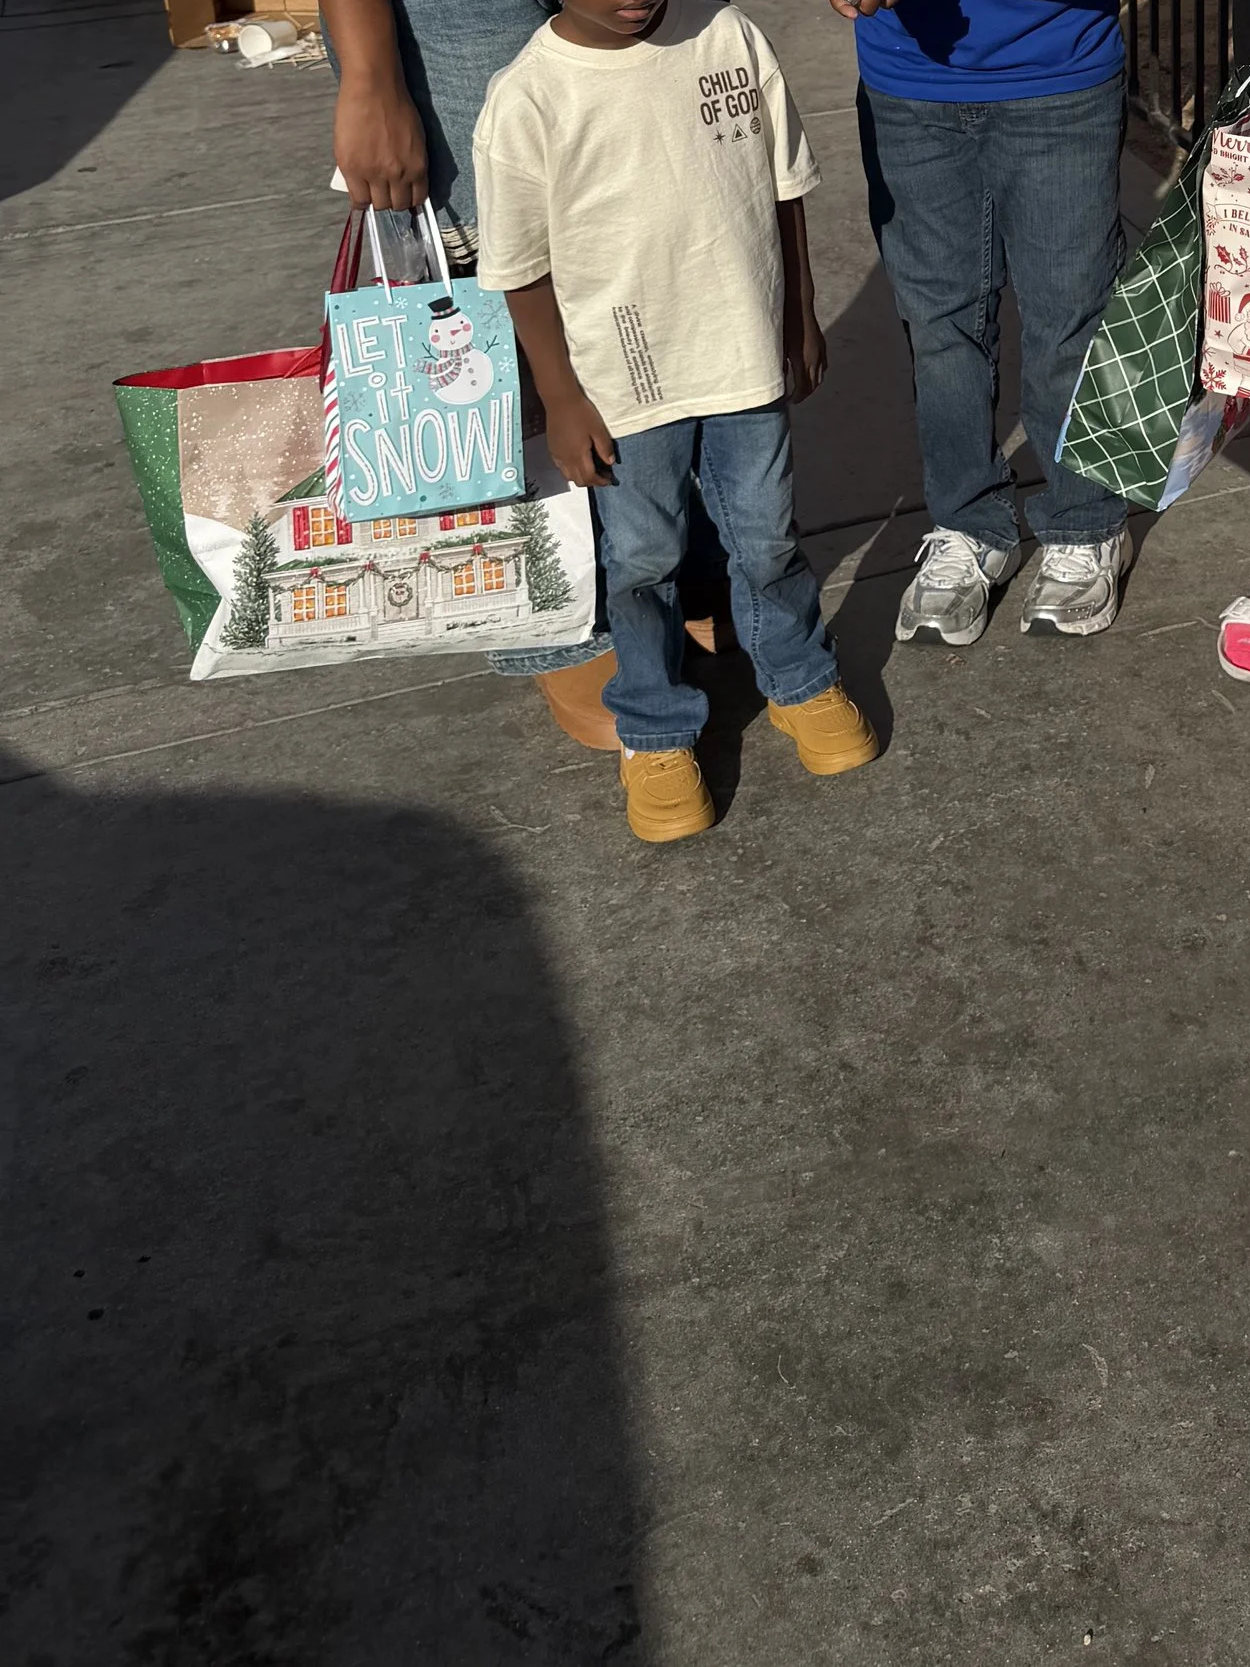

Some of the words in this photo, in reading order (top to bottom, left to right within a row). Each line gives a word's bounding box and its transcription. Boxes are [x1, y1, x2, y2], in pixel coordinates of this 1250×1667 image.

[698, 67, 749, 98] CHILD
[700, 99, 722, 126] OF
[725, 88, 759, 119] GOD
[1220, 150, 1248, 163] BRIGHT
[1223, 208, 1228, 219] I
[1229, 223, 1238, 232] IN
[336, 315, 408, 379] LET
[367, 371, 414, 425] it
[344, 391, 518, 507] SNOW!
